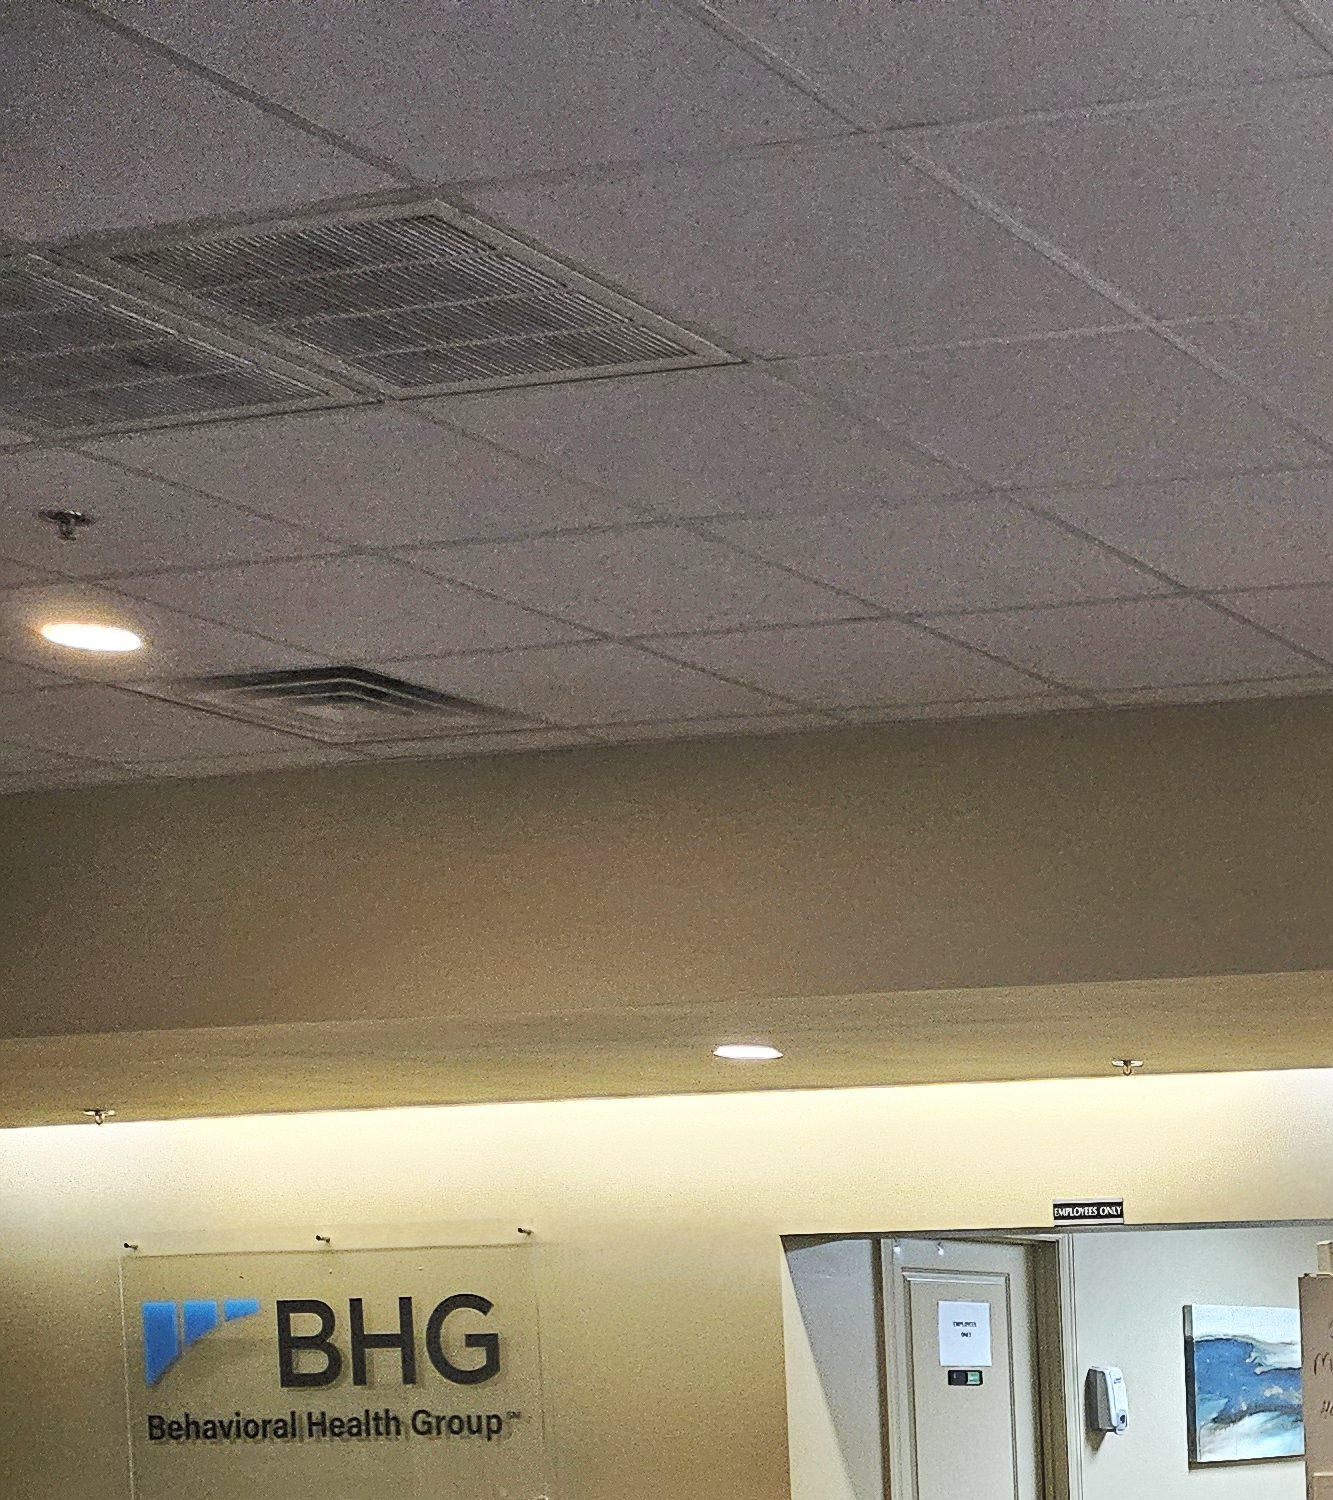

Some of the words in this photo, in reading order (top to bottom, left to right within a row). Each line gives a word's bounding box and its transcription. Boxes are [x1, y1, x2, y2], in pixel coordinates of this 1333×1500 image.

[1054, 1206, 1097, 1217] EMPLOYEES
[1099, 1205, 1122, 1216] ONLY
[276, 1293, 501, 1388] BHG
[147, 1411, 298, 1441] Behavioral
[306, 1408, 402, 1438] Health
[410, 1408, 504, 1441] Group
